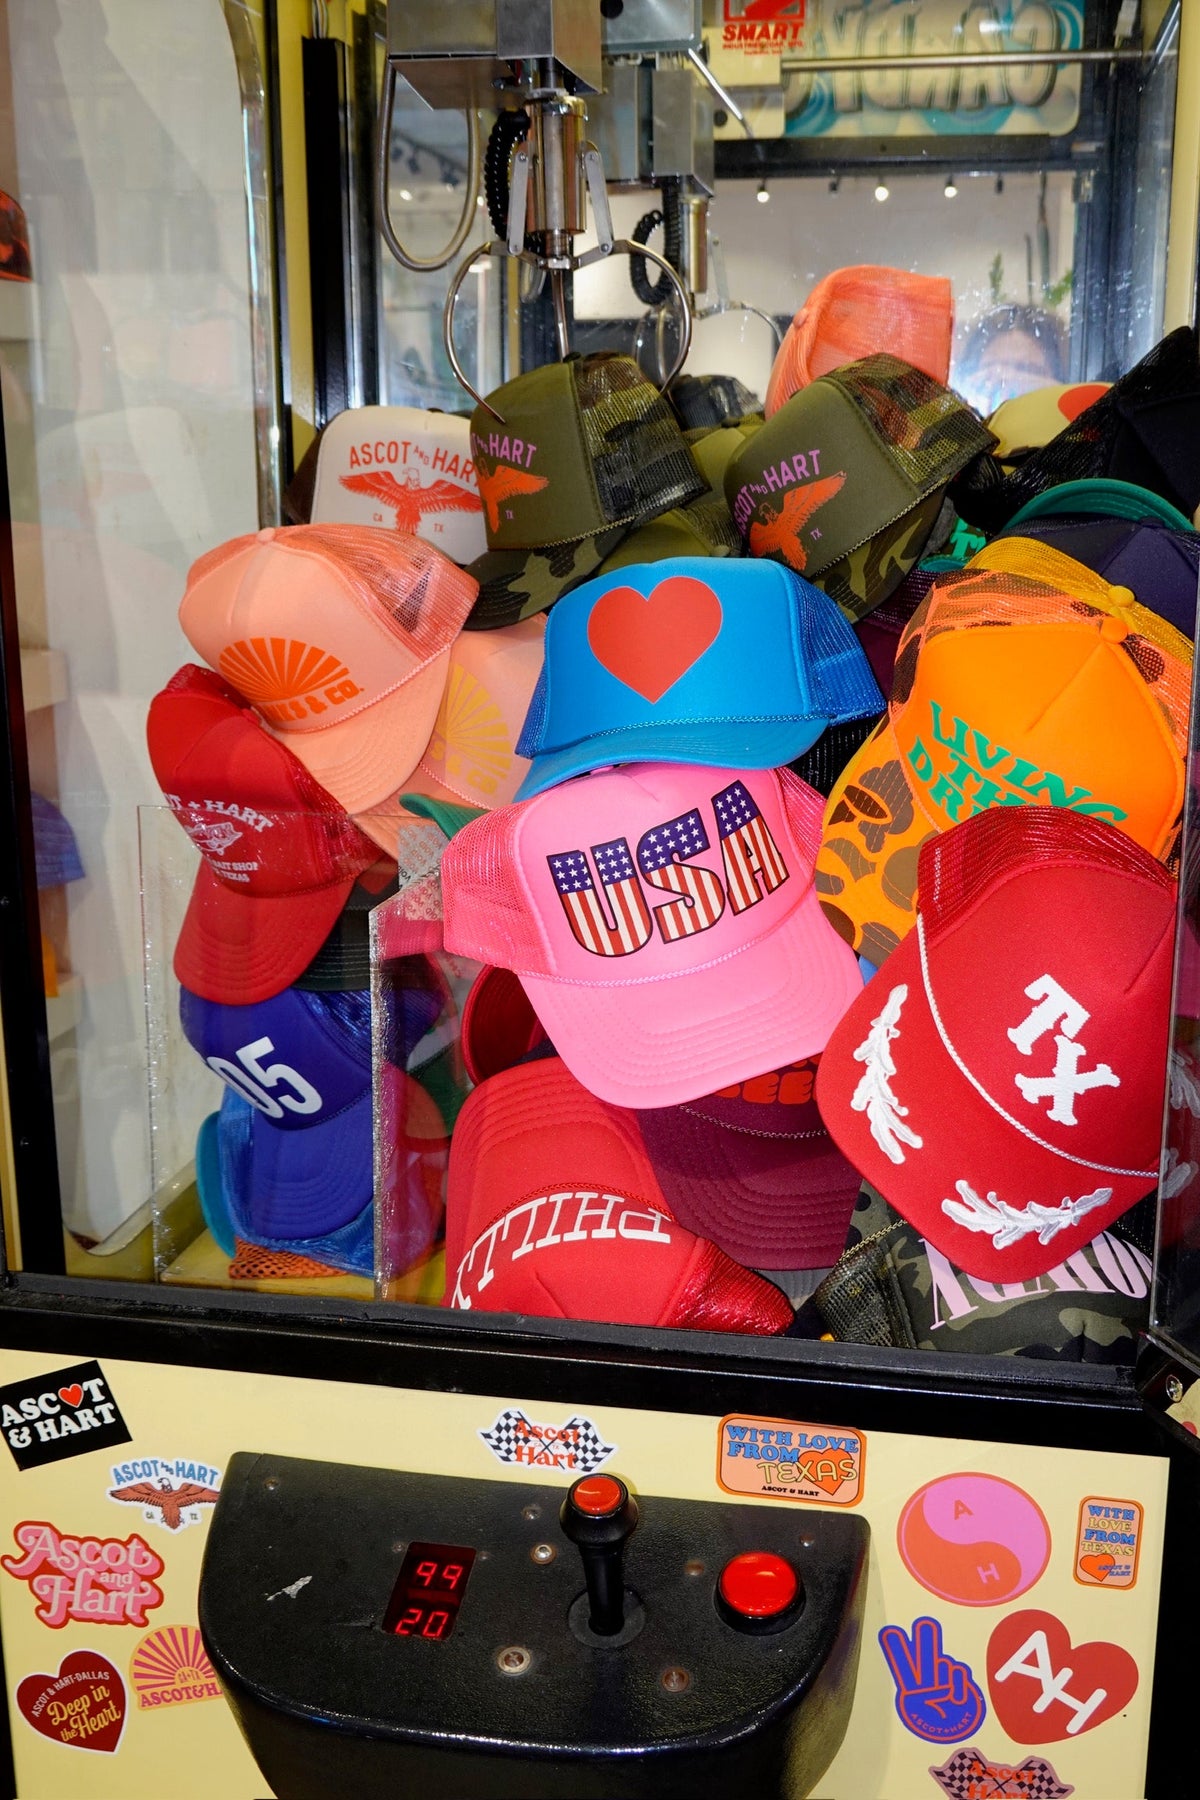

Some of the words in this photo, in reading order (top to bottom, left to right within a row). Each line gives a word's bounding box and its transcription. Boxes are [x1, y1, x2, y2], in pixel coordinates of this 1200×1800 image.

[723, 21, 804, 41] SMART
[489, 433, 537, 468] HART
[350, 441, 411, 469] ASCOT
[414, 446, 429, 465] AND
[432, 447, 478, 488] HAR
[750, 483, 768, 495] AND
[763, 449, 821, 493] HART
[373, 513, 383, 522] CA
[434, 523, 444, 533] TX
[810, 528, 823, 540] TX
[203, 800, 274, 832] HART
[546, 779, 790, 958] USA
[1007, 974, 1121, 1126] TX
[206, 1036, 323, 1119] 05
[451, 1191, 672, 1310] PHILLY
[8, 1426, 32, 1449] &
[33, 1402, 116, 1442] HART
[515, 1419, 580, 1443] Ascot
[726, 1424, 793, 1446] WITH
[798, 1433, 859, 1453] LOVE
[514, 1445, 577, 1469] Hart
[727, 1441, 800, 1463] FROM
[113, 1460, 159, 1485] ASCOT
[175, 1460, 218, 1486] HART
[757, 1458, 858, 1484] TEXAS
[761, 1485, 788, 1493] ASCOT
[953, 1499, 974, 1520] A
[1088, 1505, 1135, 1521] WITH
[1084, 1529, 1136, 1545] FROM
[1088, 1517, 1132, 1532] LOVE
[4, 1525, 152, 1571] Ascot
[1081, 1541, 1134, 1556] TEXAS
[100, 1571, 133, 1587] and
[416, 1562, 463, 1590] 99
[977, 1563, 1000, 1584] H
[32, 1567, 151, 1617] Hart
[396, 1608, 449, 1637] 20
[995, 1630, 1107, 1734] AH
[31, 1692, 50, 1717] ASCOT
[46, 1694, 91, 1726] Deep
[89, 1685, 110, 1702] in
[69, 1700, 121, 1739] Heart
[60, 1727, 79, 1742] the
[968, 1760, 1035, 1784] Ascot
